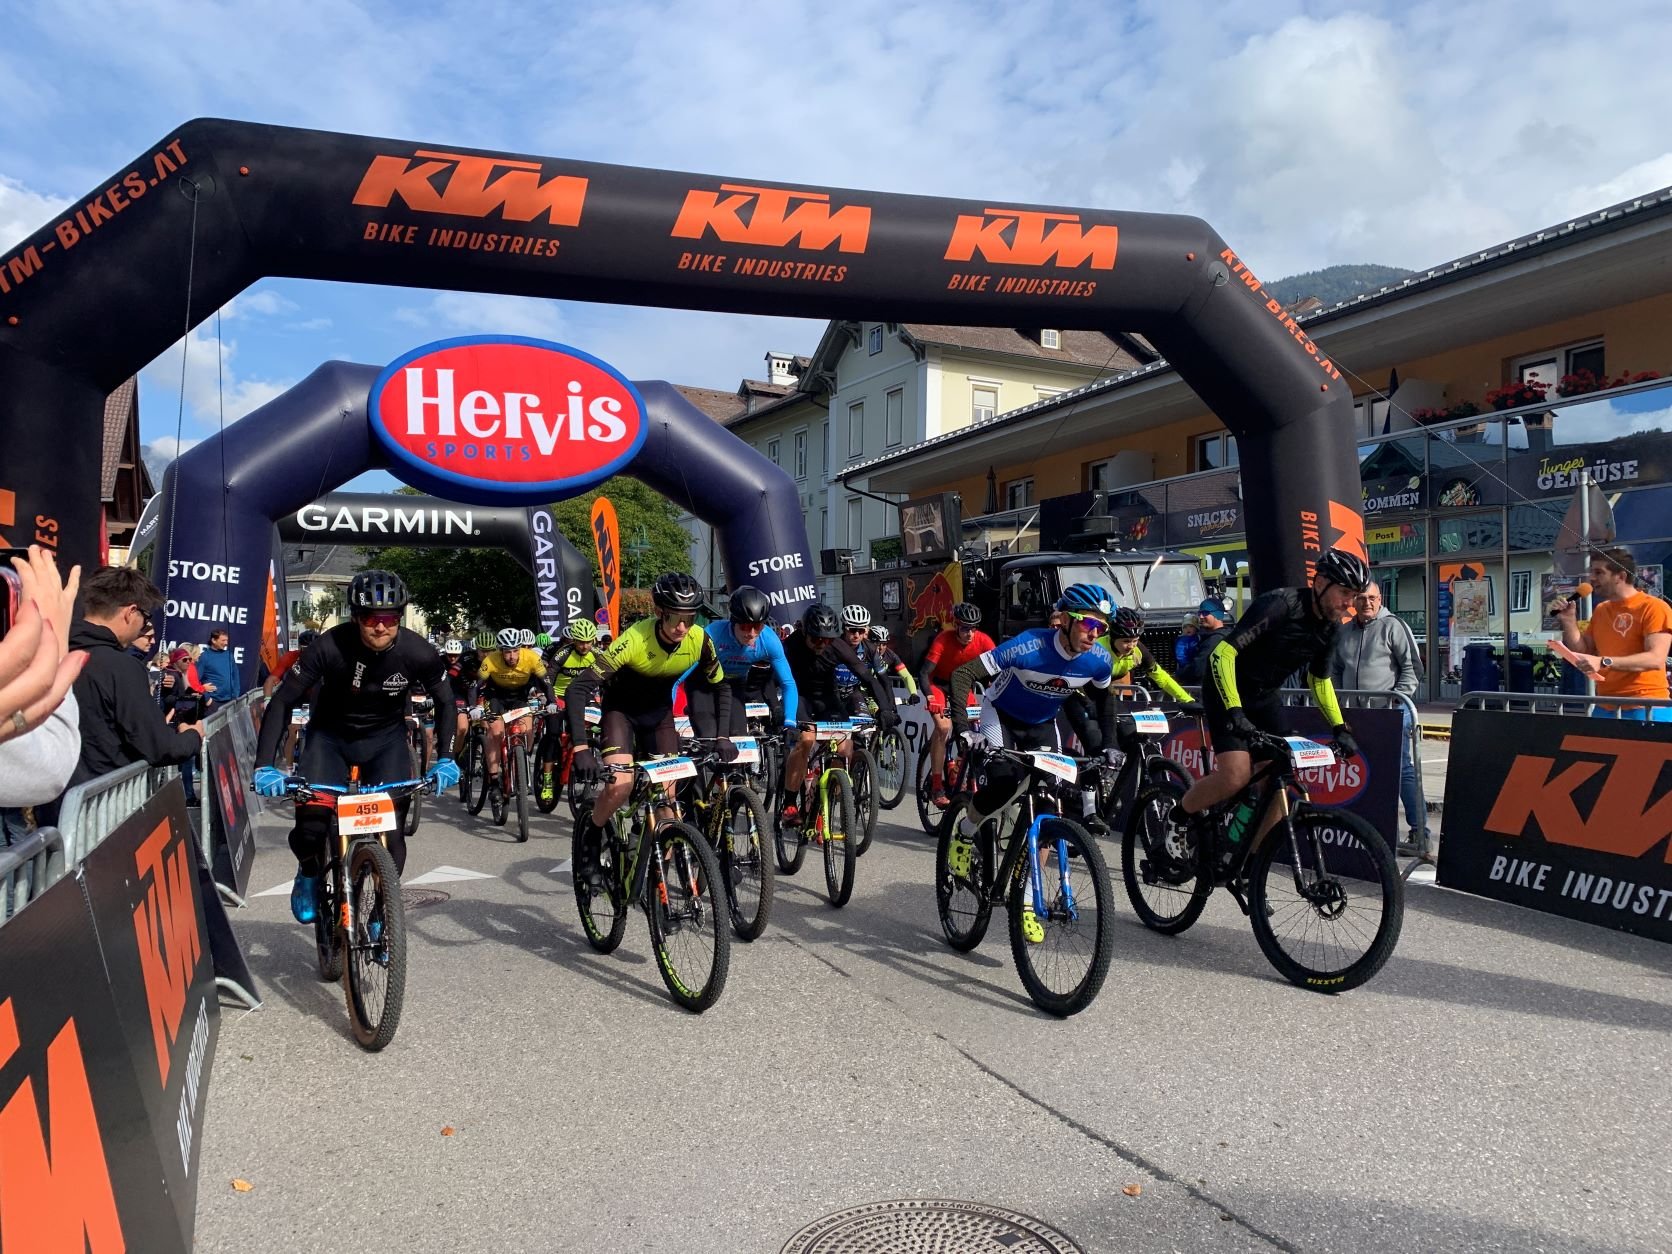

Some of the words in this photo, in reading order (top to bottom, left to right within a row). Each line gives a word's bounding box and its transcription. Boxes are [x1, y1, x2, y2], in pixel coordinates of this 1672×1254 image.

[352, 149, 589, 228] KTM
[0, 138, 188, 294] TM-BIKES.AT
[671, 183, 872, 255] KTM
[364, 222, 419, 244] BIKE
[428, 228, 560, 258] INDUSTRIES
[944, 207, 1119, 271] KTM
[677, 252, 725, 273] BIKE
[733, 258, 848, 283] INDUSTRIES
[947, 274, 991, 292] BIKE
[995, 278, 1097, 297] INDUSTRIES
[404, 366, 627, 456] Hervis
[426, 441, 531, 461] SPORTS
[296, 504, 474, 535] GARMIN
[1187, 508, 1237, 528] SNACKS
[1300, 510, 1321, 552] BIKE
[1375, 532, 1395, 541] Post
[168, 559, 241, 585] STORE
[532, 510, 560, 642] GARMIN
[748, 552, 804, 577] STORE
[766, 584, 817, 607] NLINE
[163, 599, 249, 625] ONLINE
[1089, 643, 1113, 666] NAPOL
[1297, 762, 1361, 793] ervis
[353, 816, 383, 828] KTM
[356, 803, 379, 816] 459
[1489, 855, 1552, 892] BIKE
[1560, 870, 1672, 922] INDUST
[133, 815, 201, 1090] KTM
